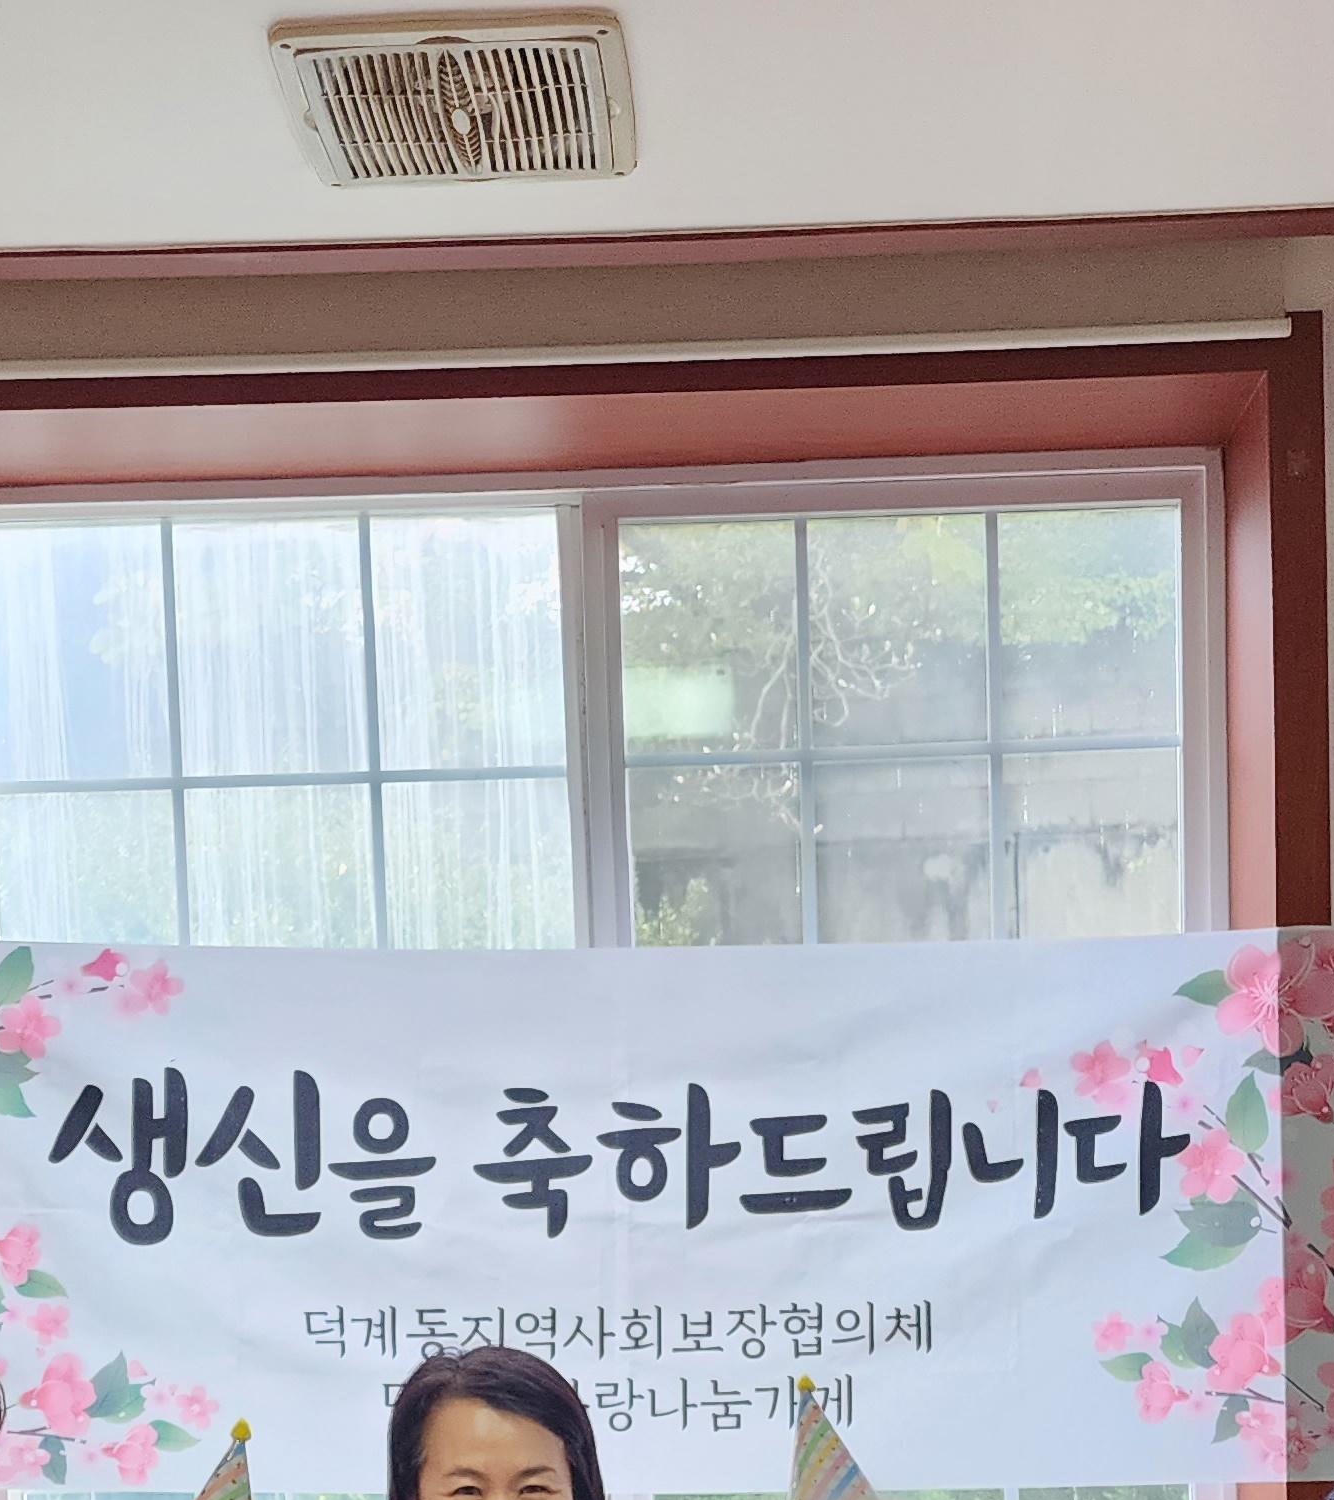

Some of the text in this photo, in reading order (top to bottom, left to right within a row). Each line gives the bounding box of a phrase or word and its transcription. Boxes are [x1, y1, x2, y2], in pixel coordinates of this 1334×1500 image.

[48, 1067, 1190, 1246] 생신을 축하드립니다
[303, 1299, 935, 1361] 덕계동지역사회보장협의체
[383, 1373, 855, 1433] 랑나눔가게
